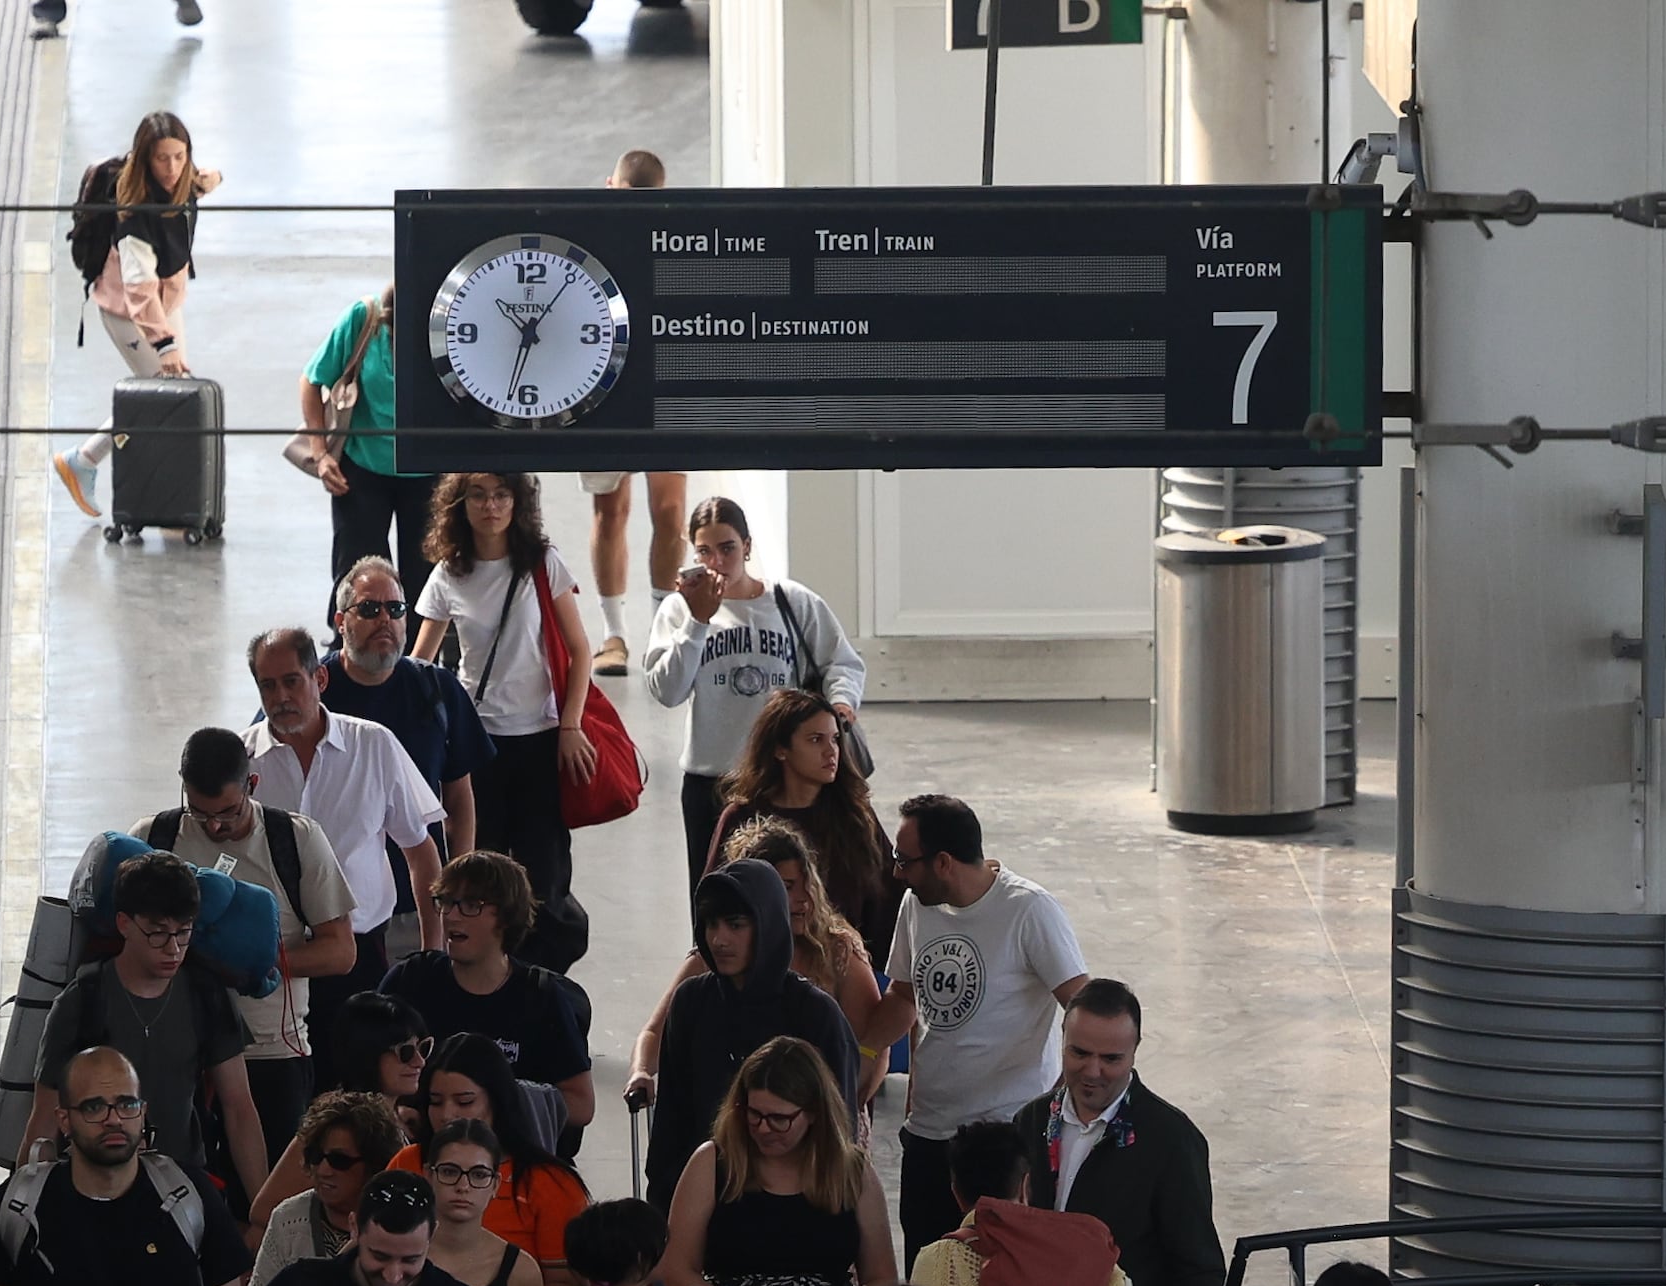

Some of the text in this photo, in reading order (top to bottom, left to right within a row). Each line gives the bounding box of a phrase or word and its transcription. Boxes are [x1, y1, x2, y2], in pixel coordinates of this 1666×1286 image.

[651, 230, 765, 251] Hora TIME
[815, 229, 934, 250] Tren TRAIN
[1196, 226, 1233, 249] Vía
[513, 263, 547, 284] 12
[1197, 263, 1281, 278] PLATFORM
[506, 304, 552, 313] FESTINA
[457, 323, 478, 344] 9
[580, 324, 601, 344] 3
[651, 313, 869, 336] Destino DESTINATION
[1213, 311, 1278, 424] 7
[518, 385, 539, 405] 6
[701, 627, 752, 666] IRGINIA
[714, 674, 726, 685] 19
[942, 943, 963, 957] V&L
[933, 971, 958, 993] 84
[953, 957, 976, 1018] VICTORIO
